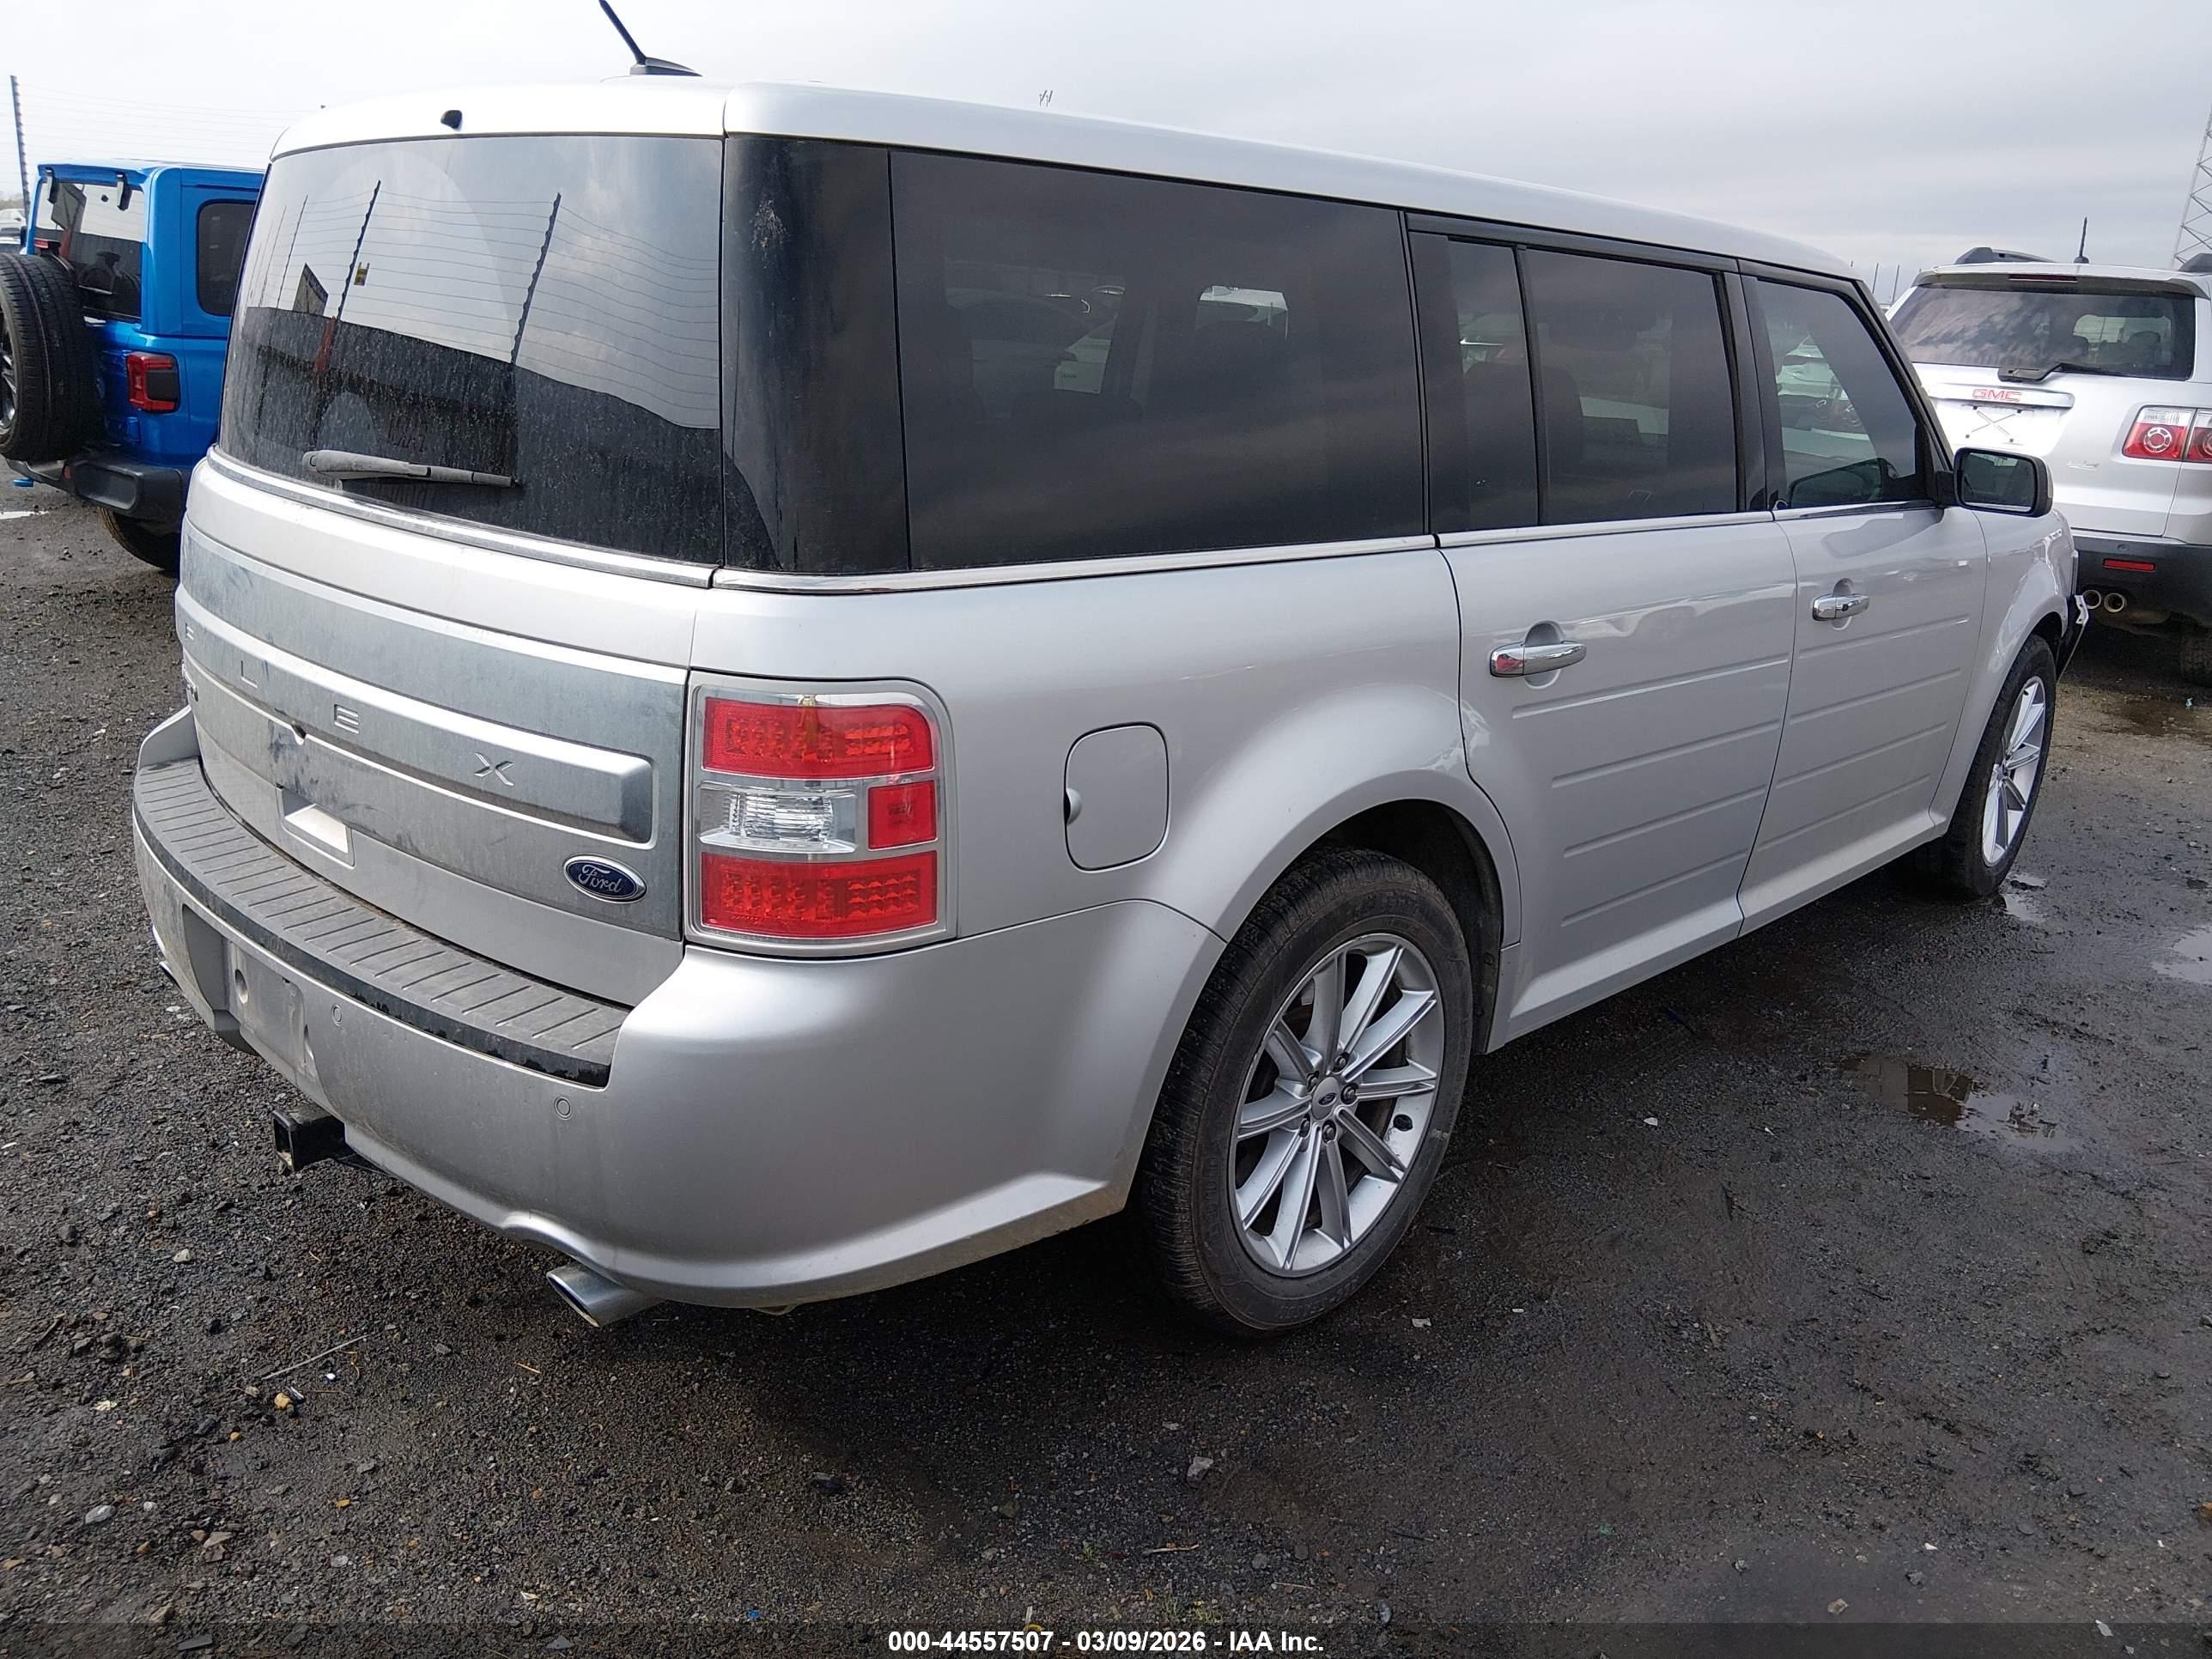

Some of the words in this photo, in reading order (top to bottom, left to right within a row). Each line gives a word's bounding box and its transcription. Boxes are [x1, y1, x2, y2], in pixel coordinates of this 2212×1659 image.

[1972, 388, 2021, 402] GMC
[184, 622, 515, 787] FLEX
[578, 864, 623, 893] Ford
